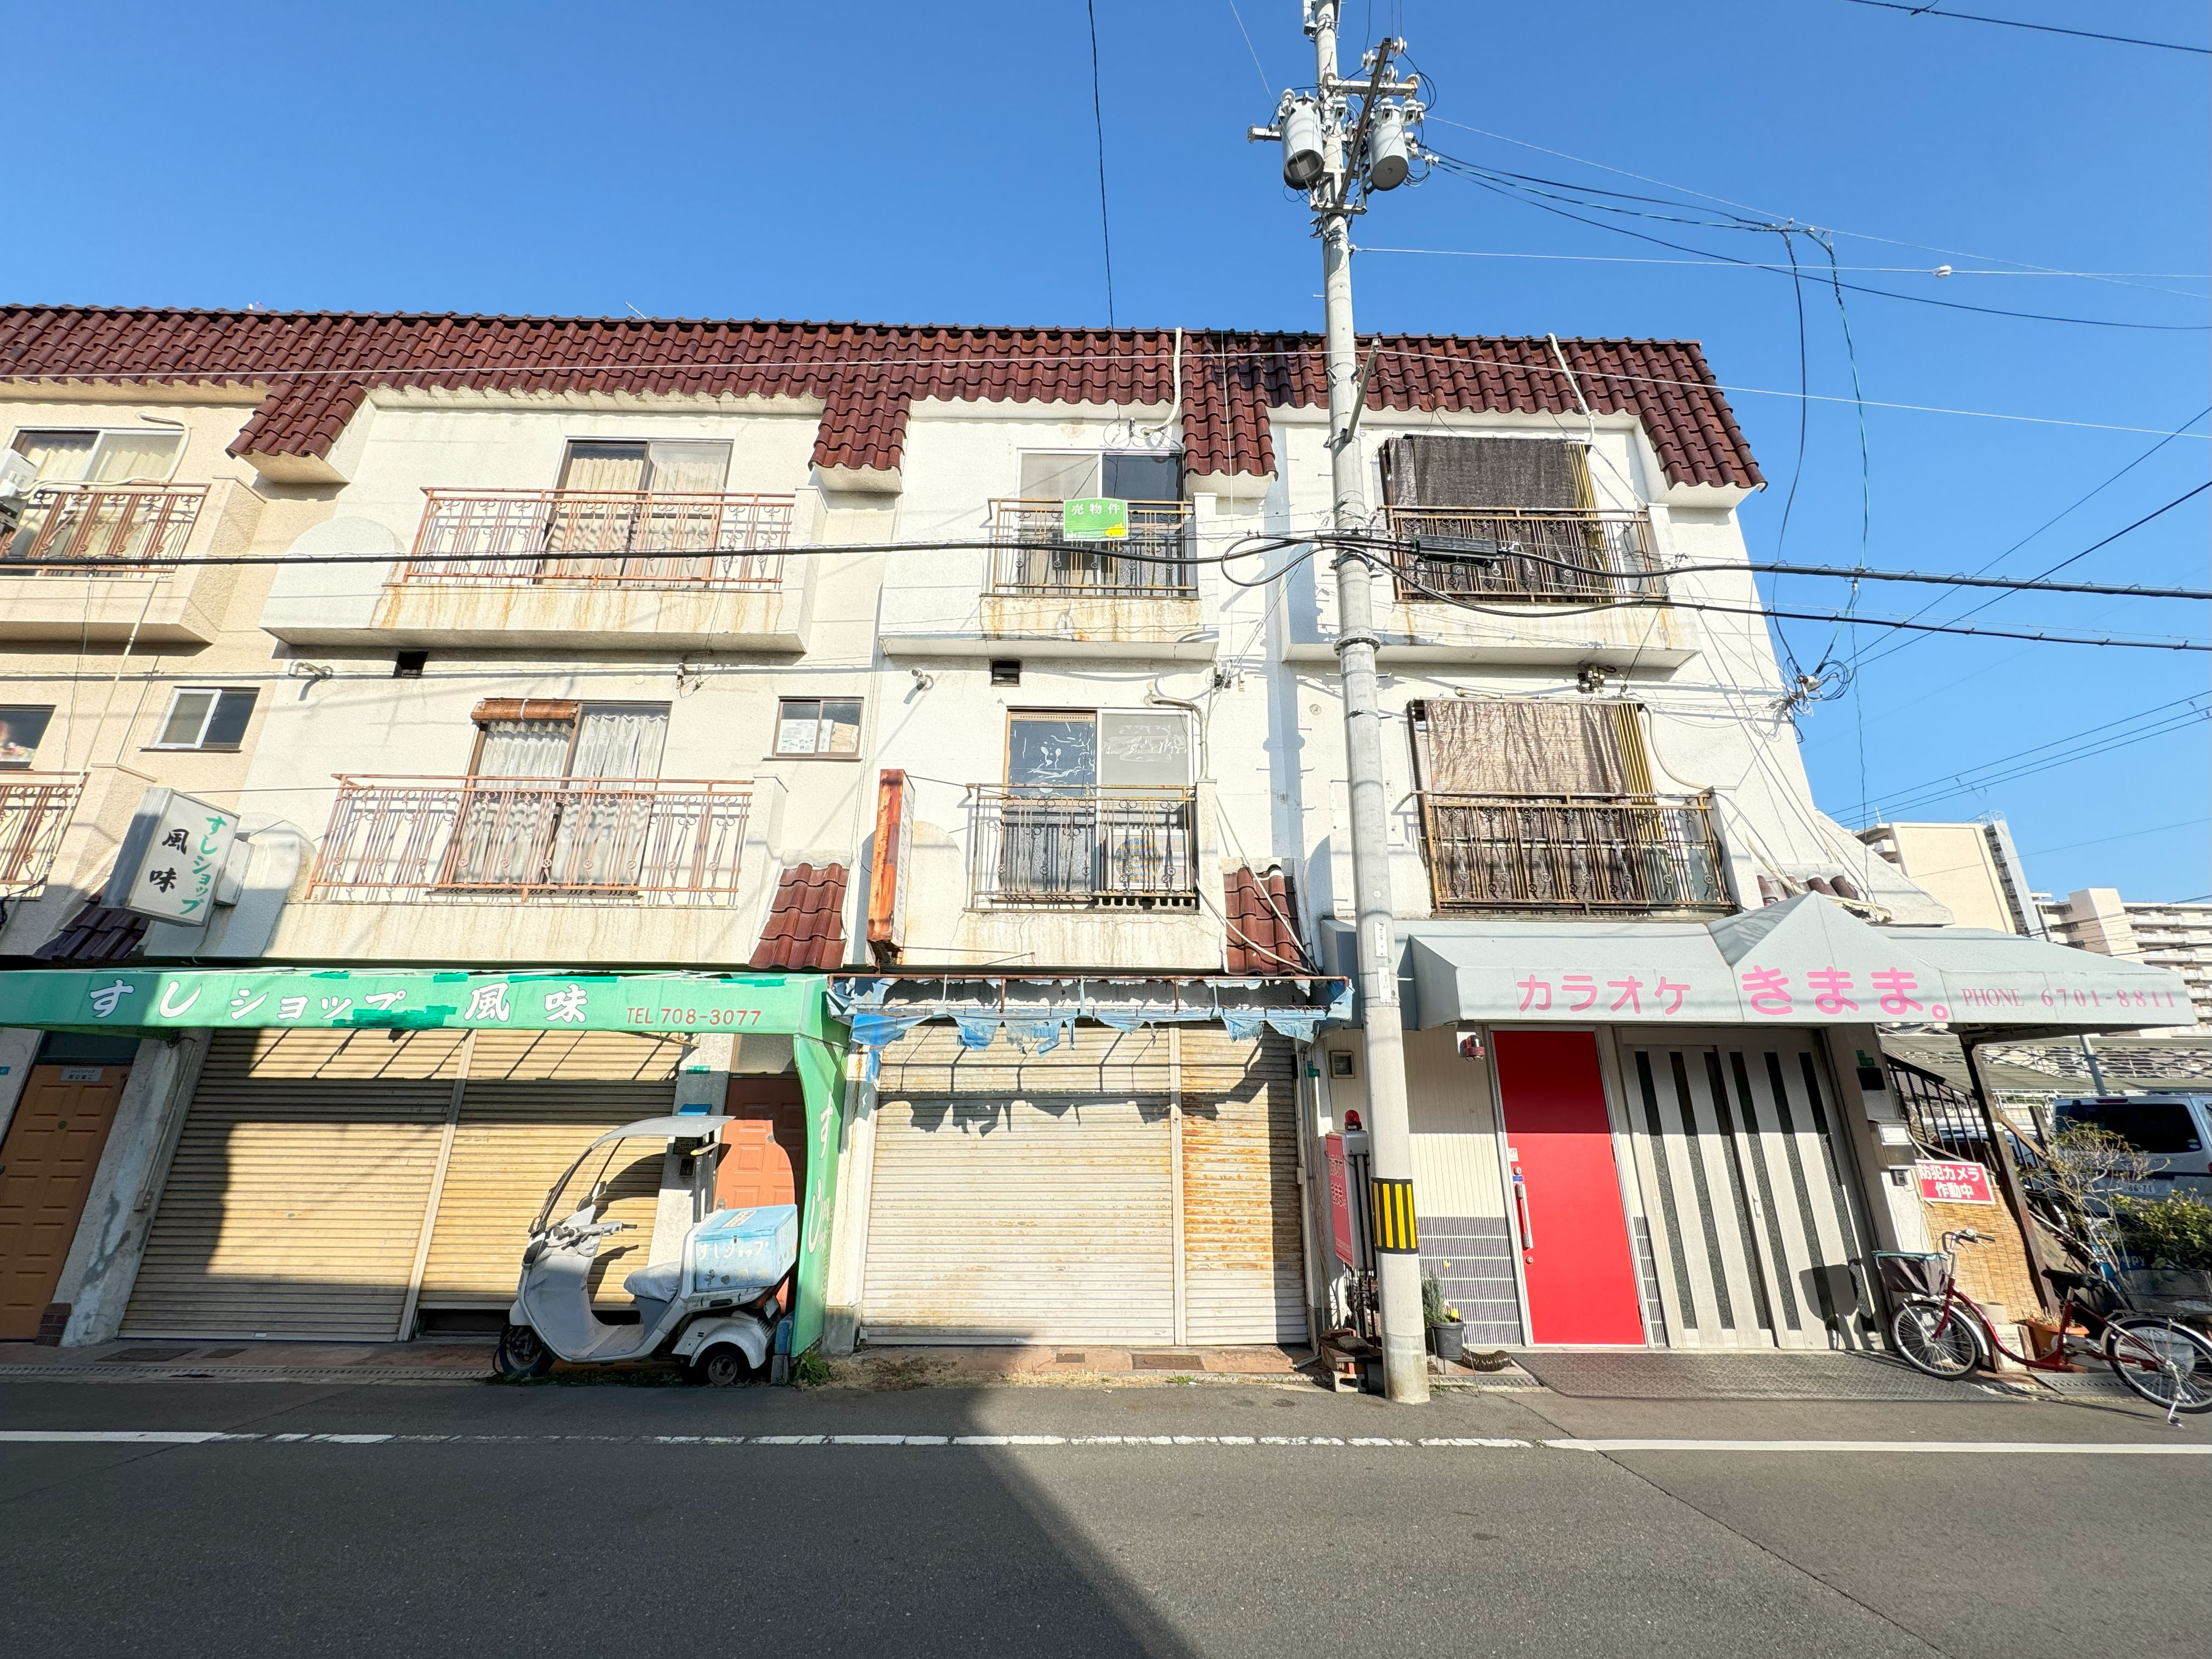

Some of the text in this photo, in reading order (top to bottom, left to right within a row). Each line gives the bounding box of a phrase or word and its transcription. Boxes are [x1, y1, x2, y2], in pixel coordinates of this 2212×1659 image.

[1071, 503, 1121, 516] 売物件
[149, 828, 190, 894] 風味
[179, 815, 228, 915] すしショップ
[89, 979, 762, 1026] すしショップ 風味 TEL 708-3077
[1517, 965, 1949, 1021] カラオケ きまま。
[1962, 988, 2176, 1008] PHONE 6701-8811
[1917, 1164, 1980, 1182] 防犯カメラ
[1935, 1181, 1975, 1199] 作動中
